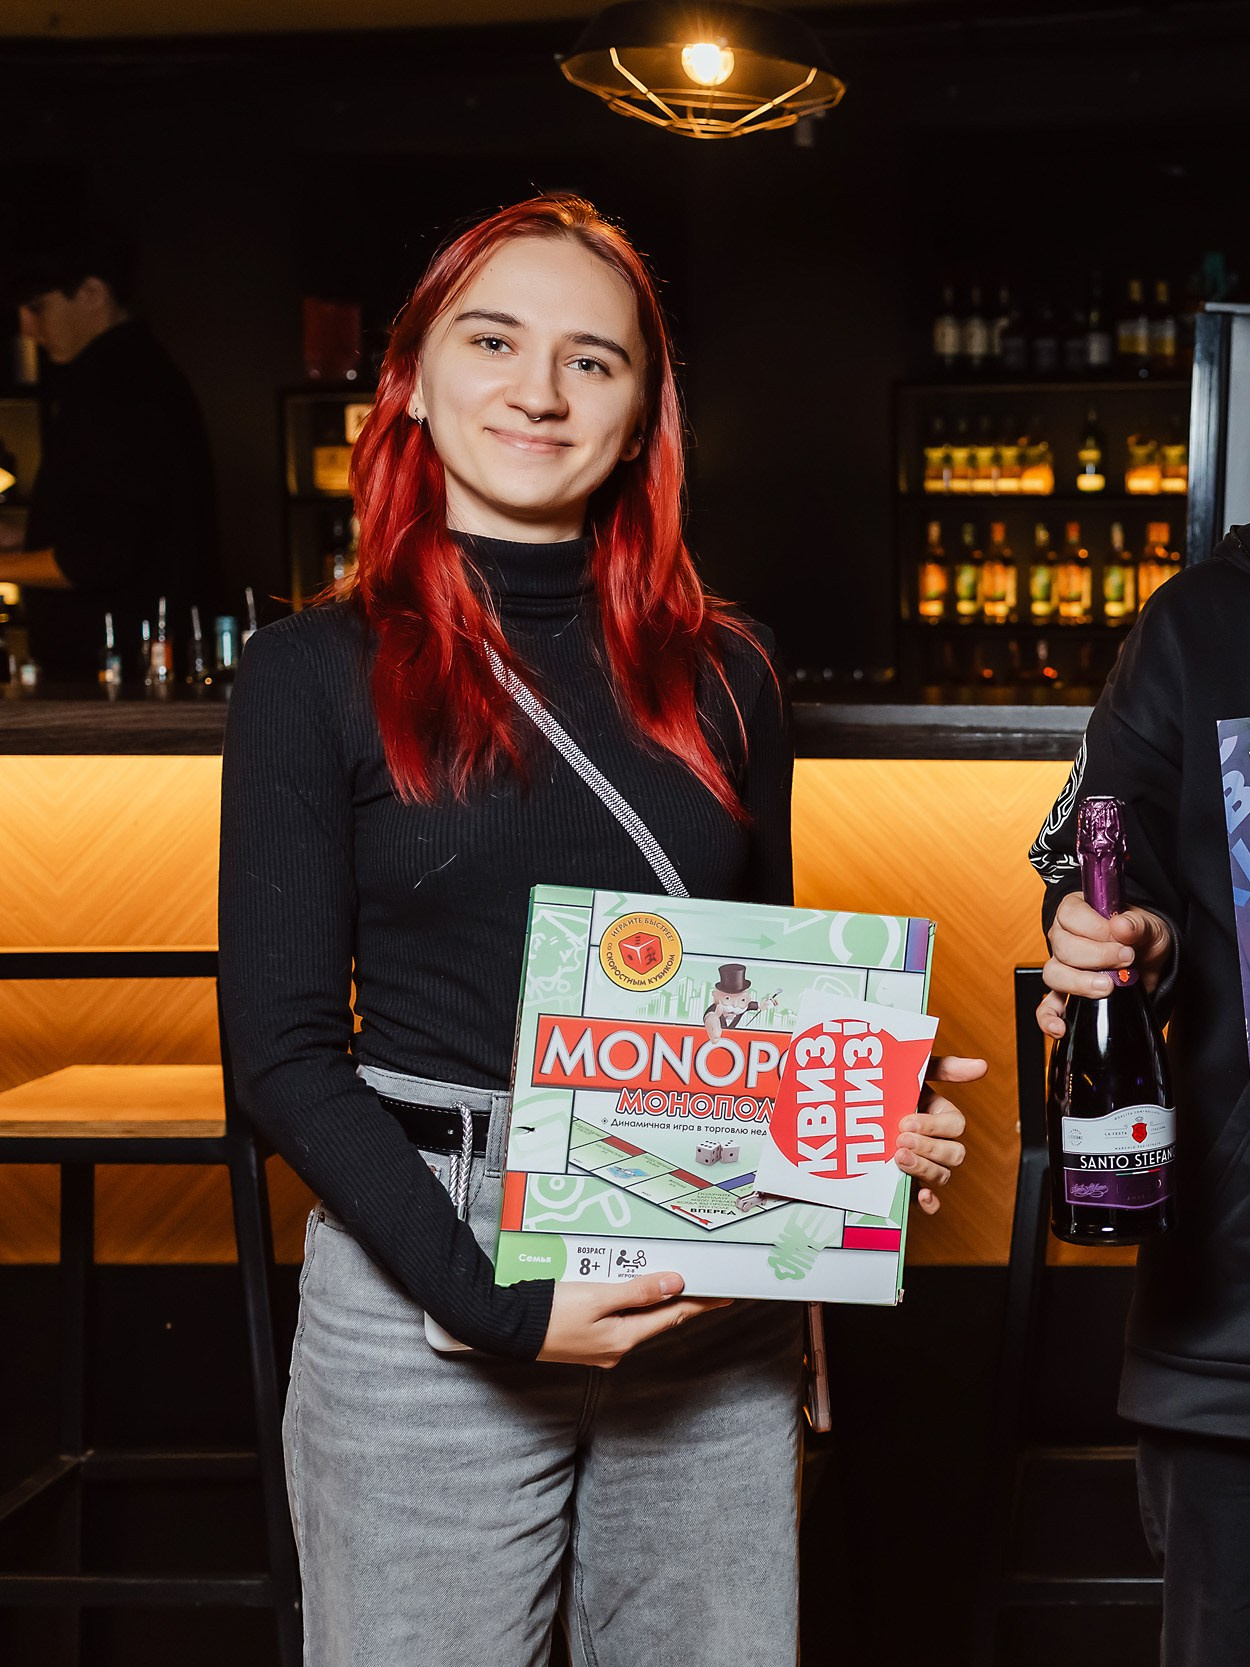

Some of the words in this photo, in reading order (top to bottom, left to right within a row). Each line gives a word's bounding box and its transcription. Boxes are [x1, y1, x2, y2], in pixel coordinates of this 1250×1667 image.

[644, 917, 675, 942] БЫСТРЕЕ!
[606, 951, 647, 986] СКОРОСТНЫМ
[647, 954, 676, 985] КУБИКОМ
[539, 1024, 789, 1088] MONOP
[842, 1020, 886, 1176] ПЛИЗ!
[611, 1118, 671, 1130] Динамичная
[673, 1123, 695, 1132] игра
[705, 1126, 749, 1136] торговлю
[1080, 1155, 1129, 1169] SANTO
[518, 1253, 552, 1264] Семья
[577, 1246, 606, 1255] ВОЗРАСТ
[579, 1257, 601, 1276] 8+
